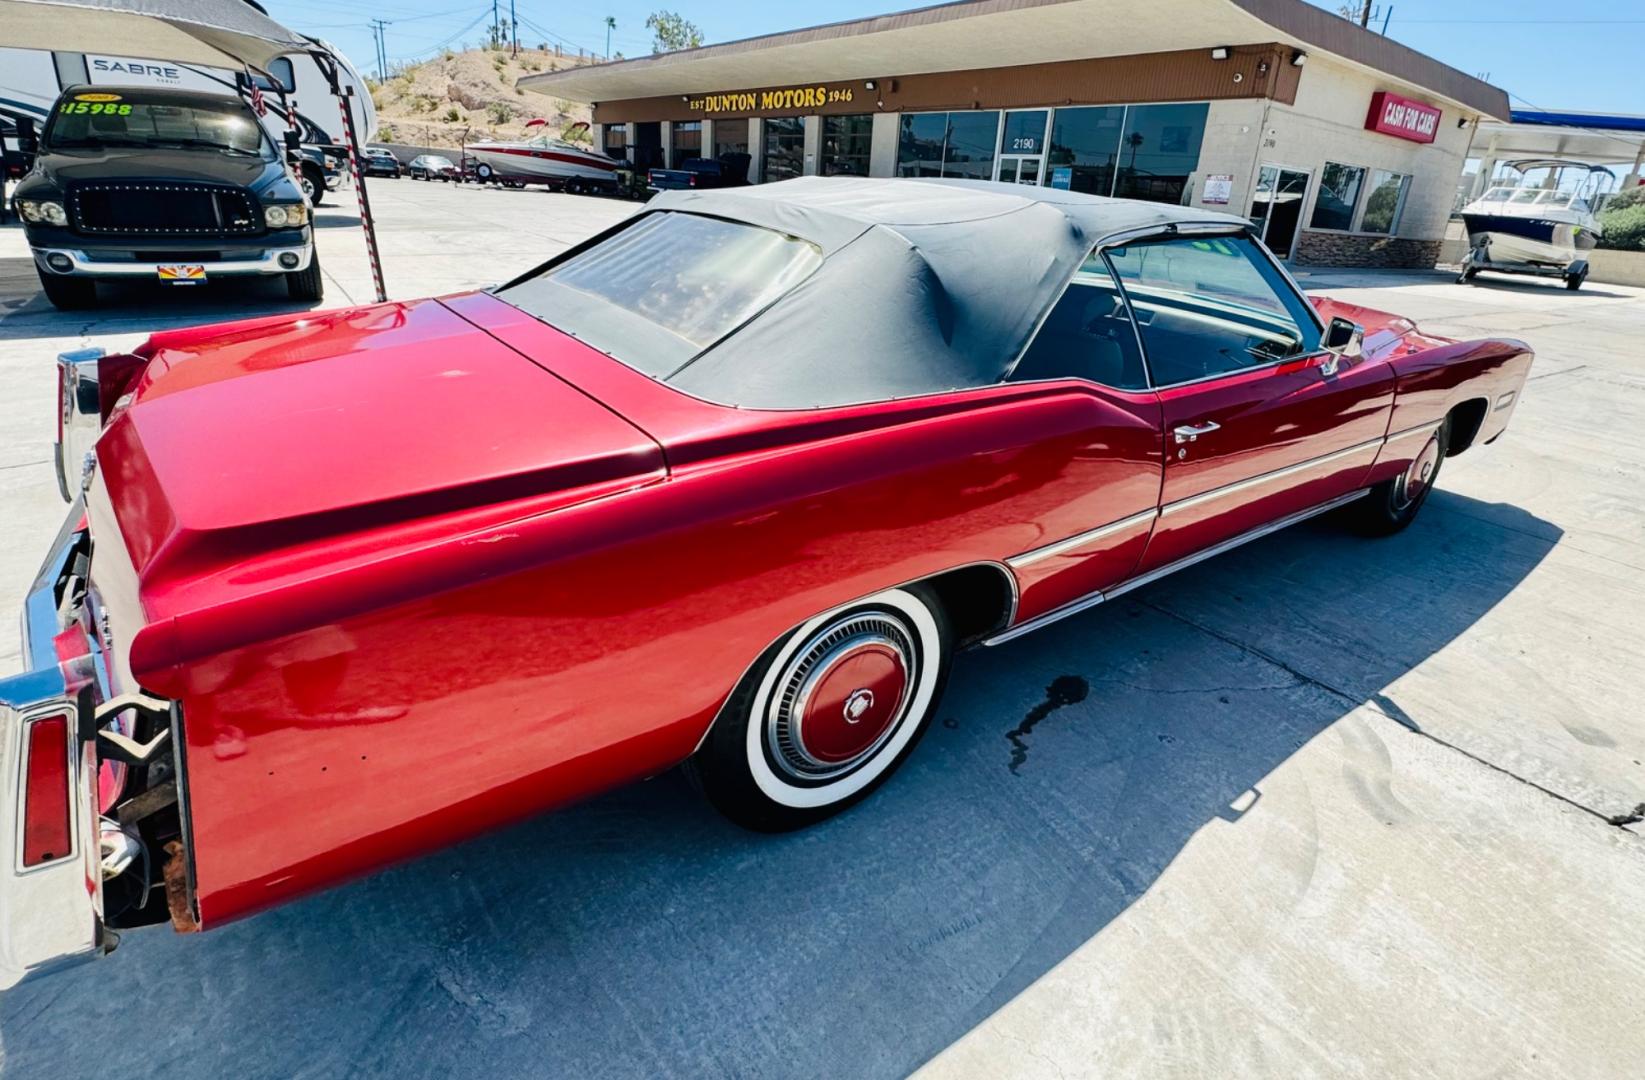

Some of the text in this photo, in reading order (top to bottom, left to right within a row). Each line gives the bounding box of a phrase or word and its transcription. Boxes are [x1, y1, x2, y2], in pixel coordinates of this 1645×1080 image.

[94, 60, 180, 79] SABRE
[60, 102, 132, 116] $15988
[690, 87, 853, 112] EST DUNTON MOTORS 1946
[1384, 102, 1436, 135] CASH FOR CARS
[1013, 138, 1034, 149] 2190
